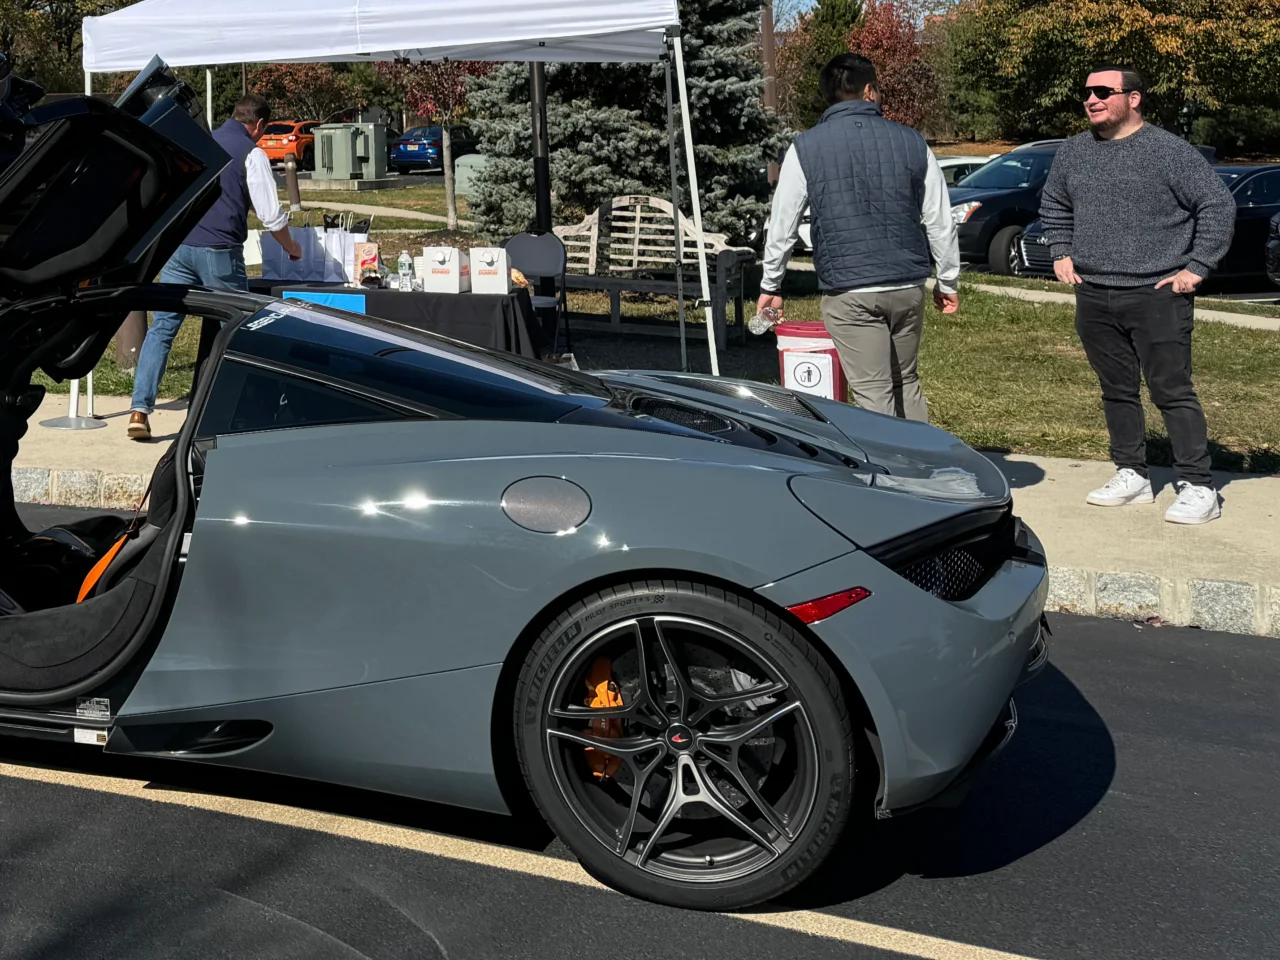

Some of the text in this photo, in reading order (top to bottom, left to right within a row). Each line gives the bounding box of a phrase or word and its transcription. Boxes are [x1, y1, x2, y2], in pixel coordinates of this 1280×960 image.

[585, 607, 606, 622] PILOT
[609, 598, 637, 609] SPORT
[529, 623, 581, 695] MICHELIN
[786, 798, 839, 878] MICHELIN
